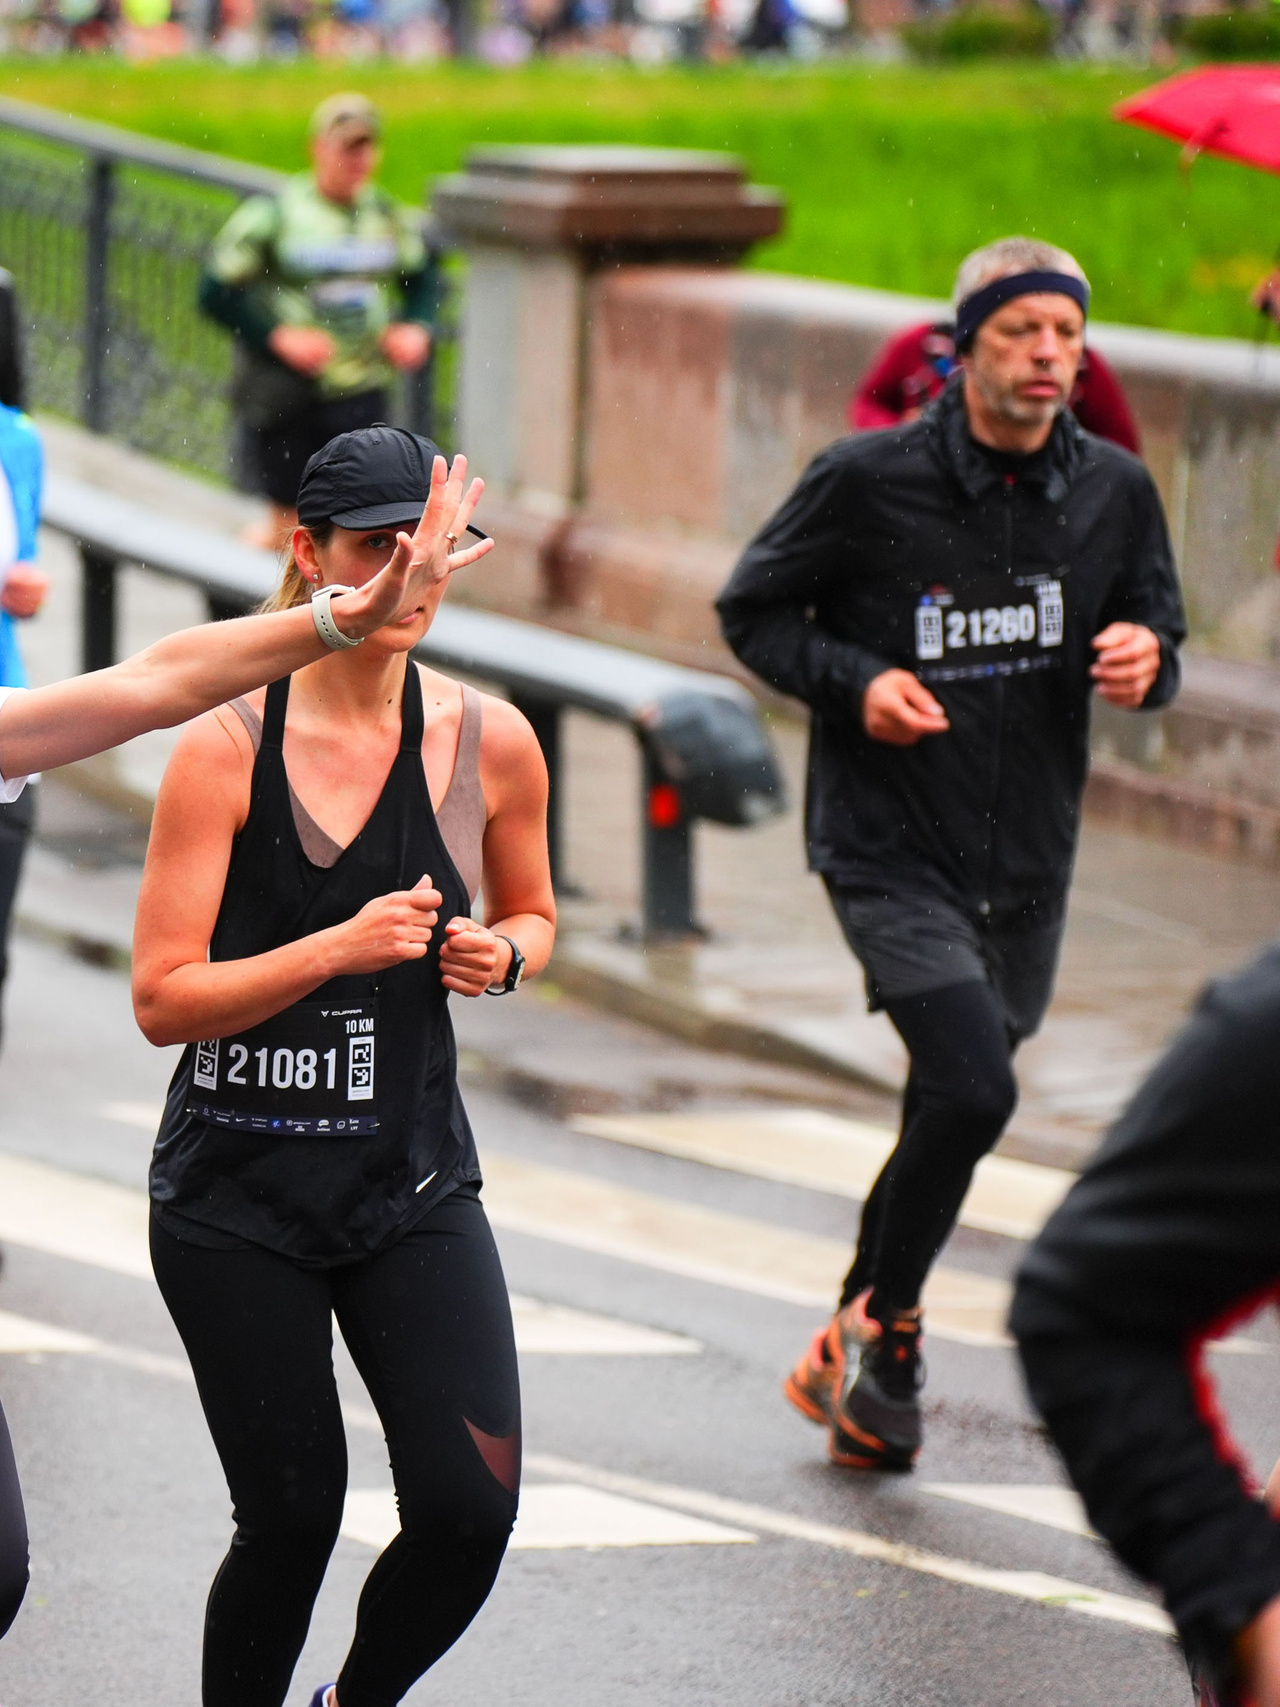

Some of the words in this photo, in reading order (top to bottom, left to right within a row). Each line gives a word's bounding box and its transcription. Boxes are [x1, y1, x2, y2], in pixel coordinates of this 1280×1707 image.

[945, 603, 1036, 648] 21260
[331, 1008, 362, 1016] CUPRA
[345, 1020, 357, 1034] 10
[358, 1018, 374, 1033] KM
[227, 1043, 337, 1090] 21081
